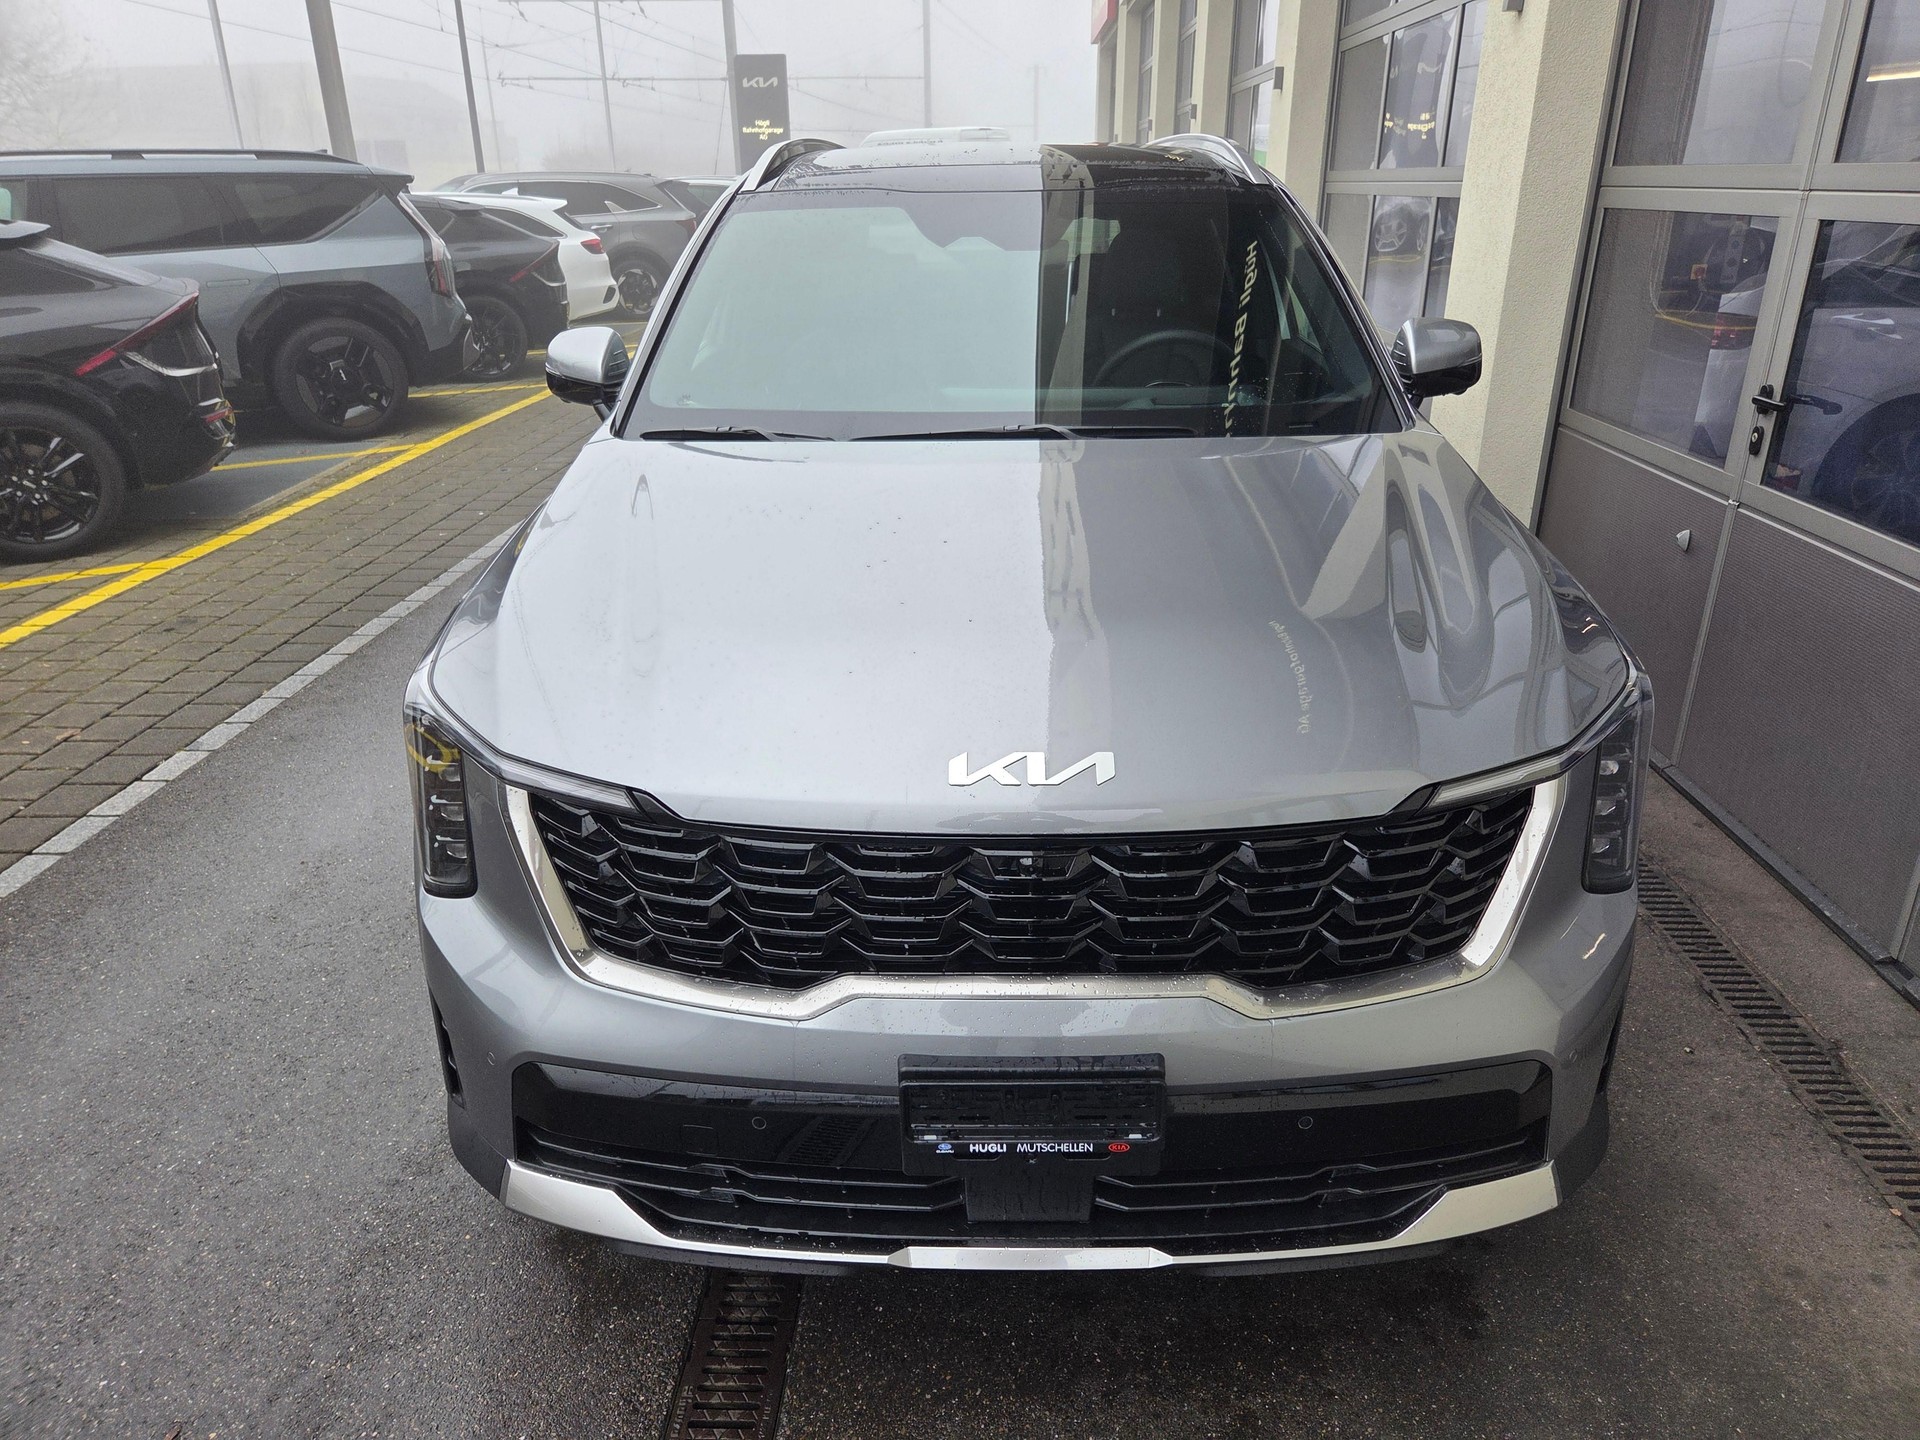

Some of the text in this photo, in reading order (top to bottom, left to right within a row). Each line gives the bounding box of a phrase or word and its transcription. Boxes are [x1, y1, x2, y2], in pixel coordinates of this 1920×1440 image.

[742, 77, 779, 88] KIA
[948, 751, 1116, 786] KIA
[969, 1143, 1007, 1153] HUGLI
[1016, 1143, 1093, 1153] MUTSCHELLEN
